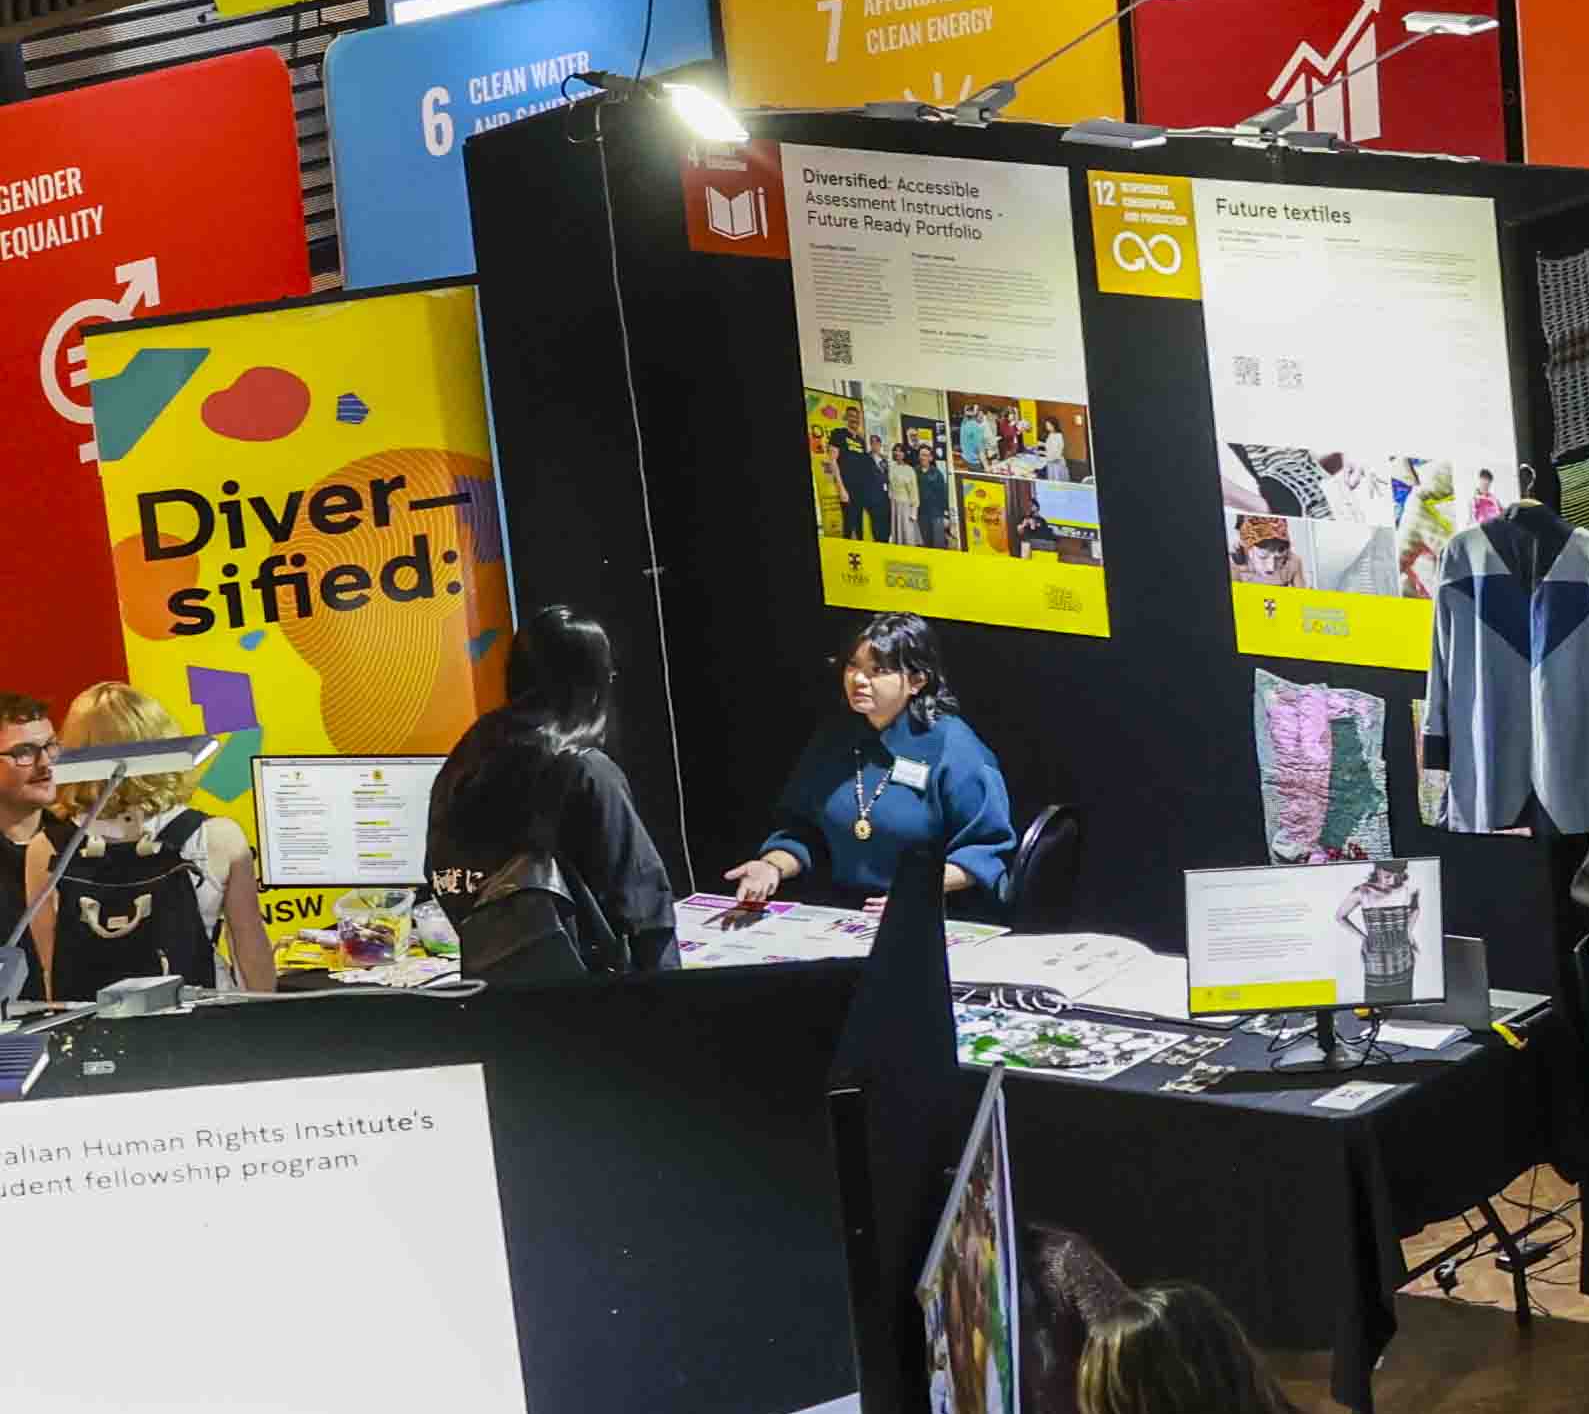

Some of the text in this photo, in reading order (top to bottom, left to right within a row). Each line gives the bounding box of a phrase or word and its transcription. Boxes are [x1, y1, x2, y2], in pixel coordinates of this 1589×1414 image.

[865, 5, 993, 56] CLEAN ENERGY
[468, 66, 527, 105] CLEAN
[422, 86, 454, 157] 6
[0, 167, 83, 215] GENDER
[806, 190, 993, 221] Assessment Instructions
[897, 176, 980, 198] Accessible
[1093, 181, 1117, 206] 12
[0, 204, 104, 261] EQUALITY
[807, 211, 983, 241] Future Ready Portfolio
[1216, 198, 1352, 224] Future textiles
[166, 534, 465, 636] sified:
[82, 1109, 435, 1160] Human Rights Institute's
[85, 1149, 360, 1193] fellowship program
